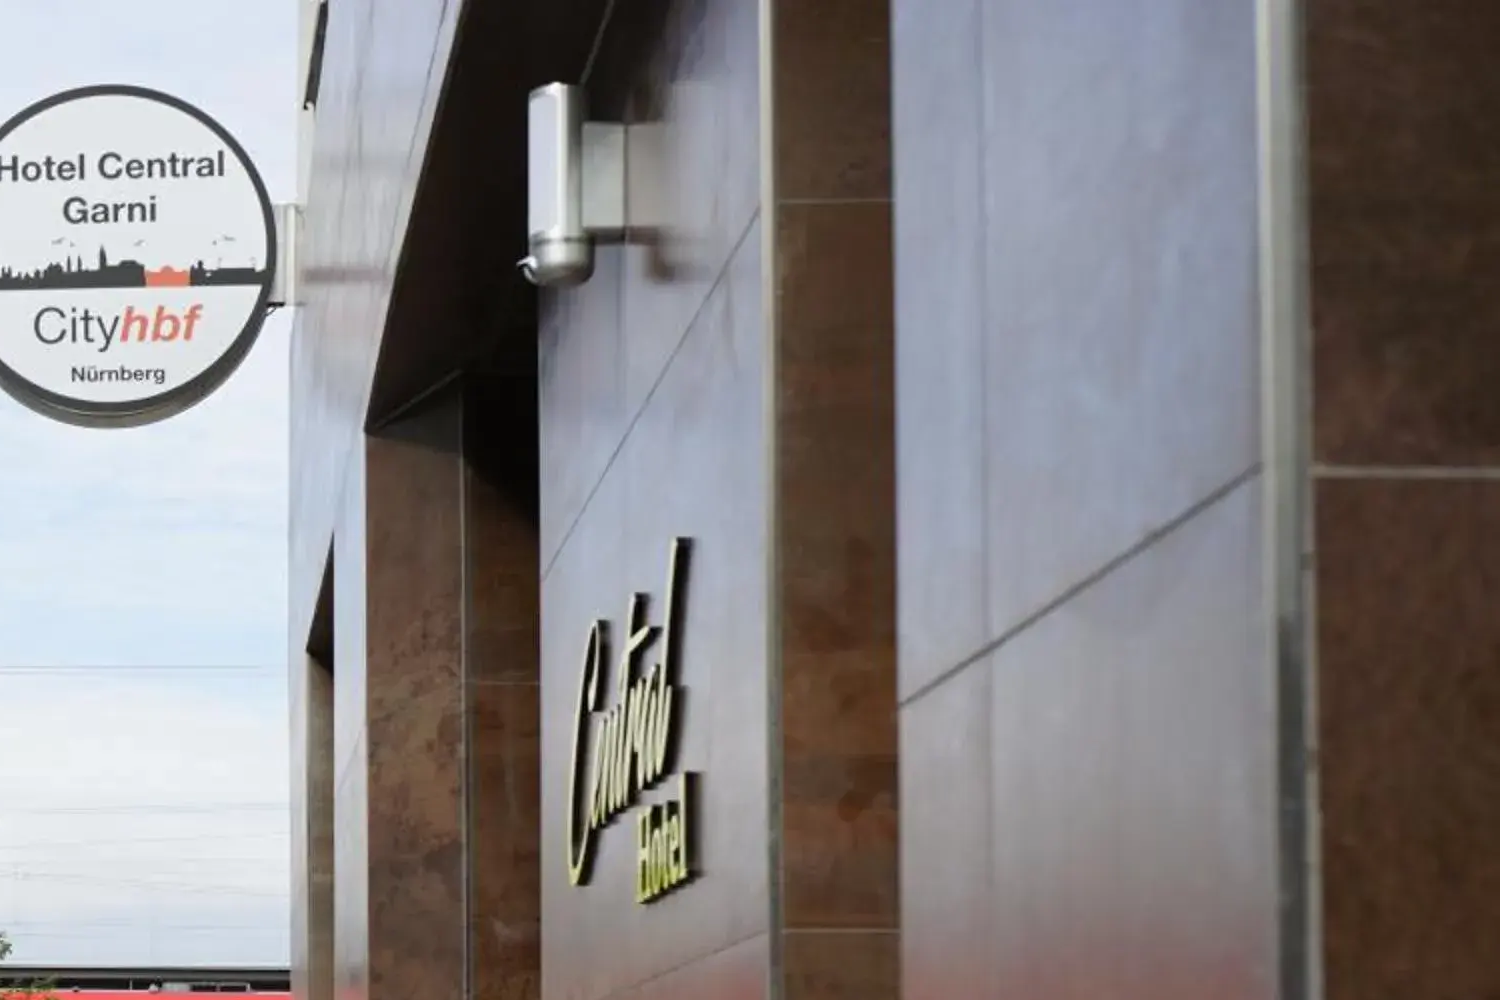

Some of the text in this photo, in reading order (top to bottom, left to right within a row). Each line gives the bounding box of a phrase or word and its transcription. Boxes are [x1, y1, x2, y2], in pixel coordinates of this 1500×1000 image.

[98, 150, 225, 180] Central
[63, 195, 157, 224] Garni
[33, 304, 203, 352] Cityhbf
[71, 366, 166, 384] Nürnberg
[636, 771, 697, 902] Hotel
